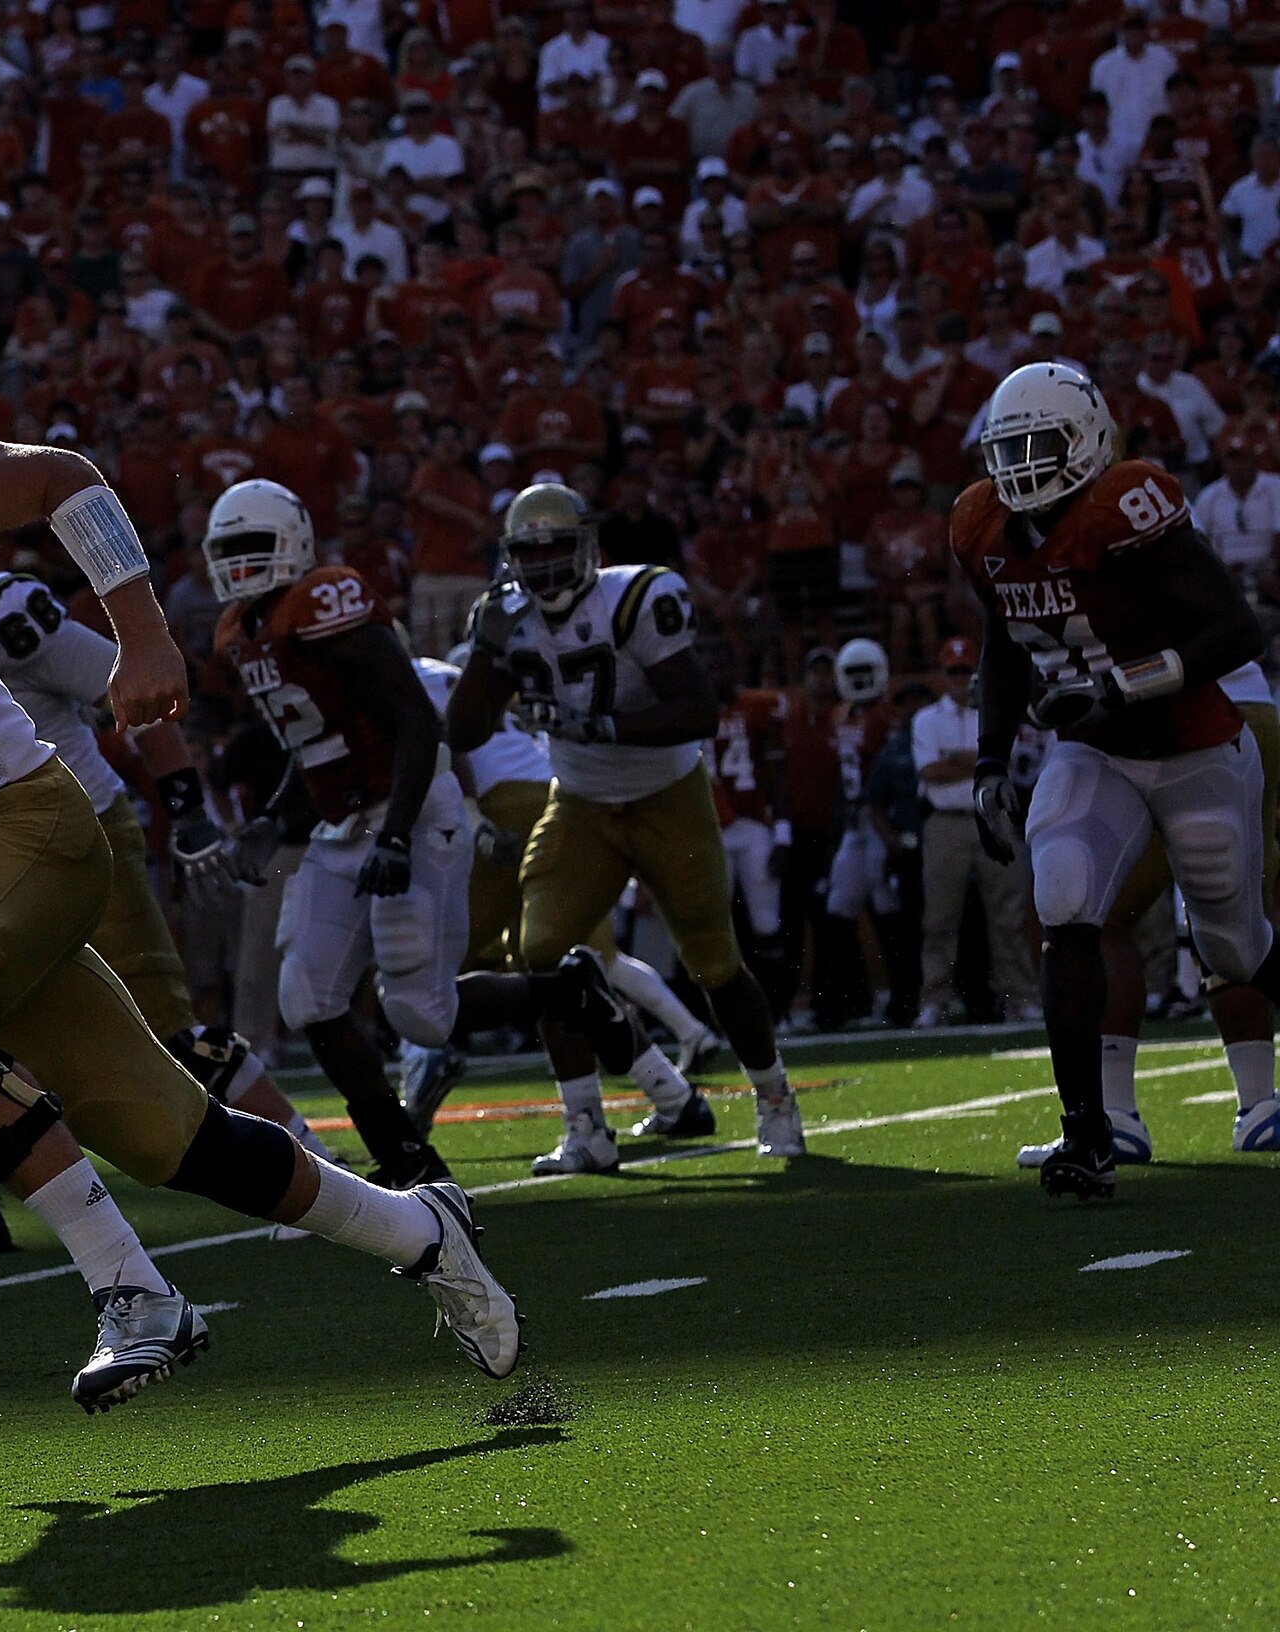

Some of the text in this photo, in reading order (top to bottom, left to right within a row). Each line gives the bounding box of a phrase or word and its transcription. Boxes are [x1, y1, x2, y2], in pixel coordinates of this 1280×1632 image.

[1118, 476, 1176, 532] 81
[310, 577, 366, 621] 32
[993, 578, 1077, 618] TEXAS
